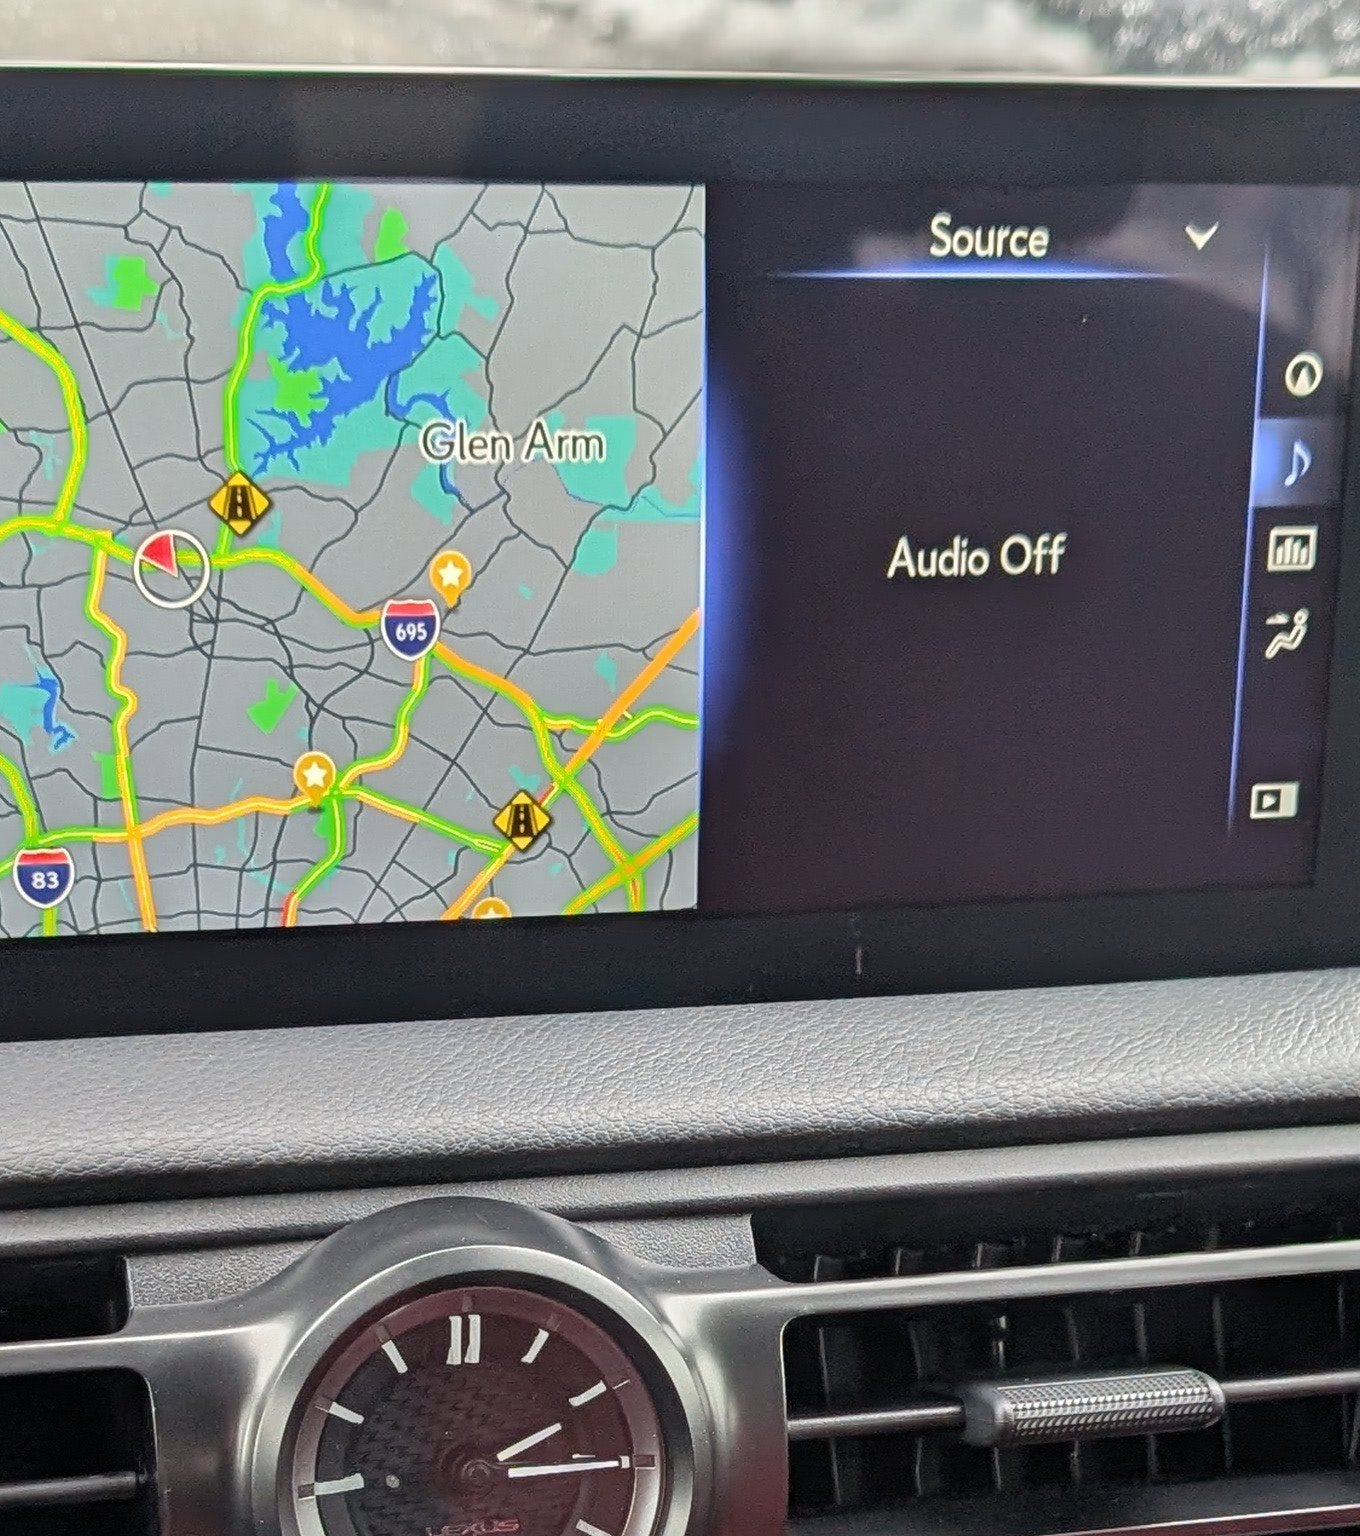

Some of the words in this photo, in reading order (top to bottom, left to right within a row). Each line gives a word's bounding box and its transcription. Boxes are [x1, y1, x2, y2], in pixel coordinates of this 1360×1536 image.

[929, 212, 1050, 258] Source
[422, 419, 511, 462] Glen
[524, 419, 606, 462] Arm
[886, 535, 990, 579] Audio
[1000, 532, 1068, 575] Off
[395, 622, 428, 642] 695
[31, 871, 60, 890] 83
